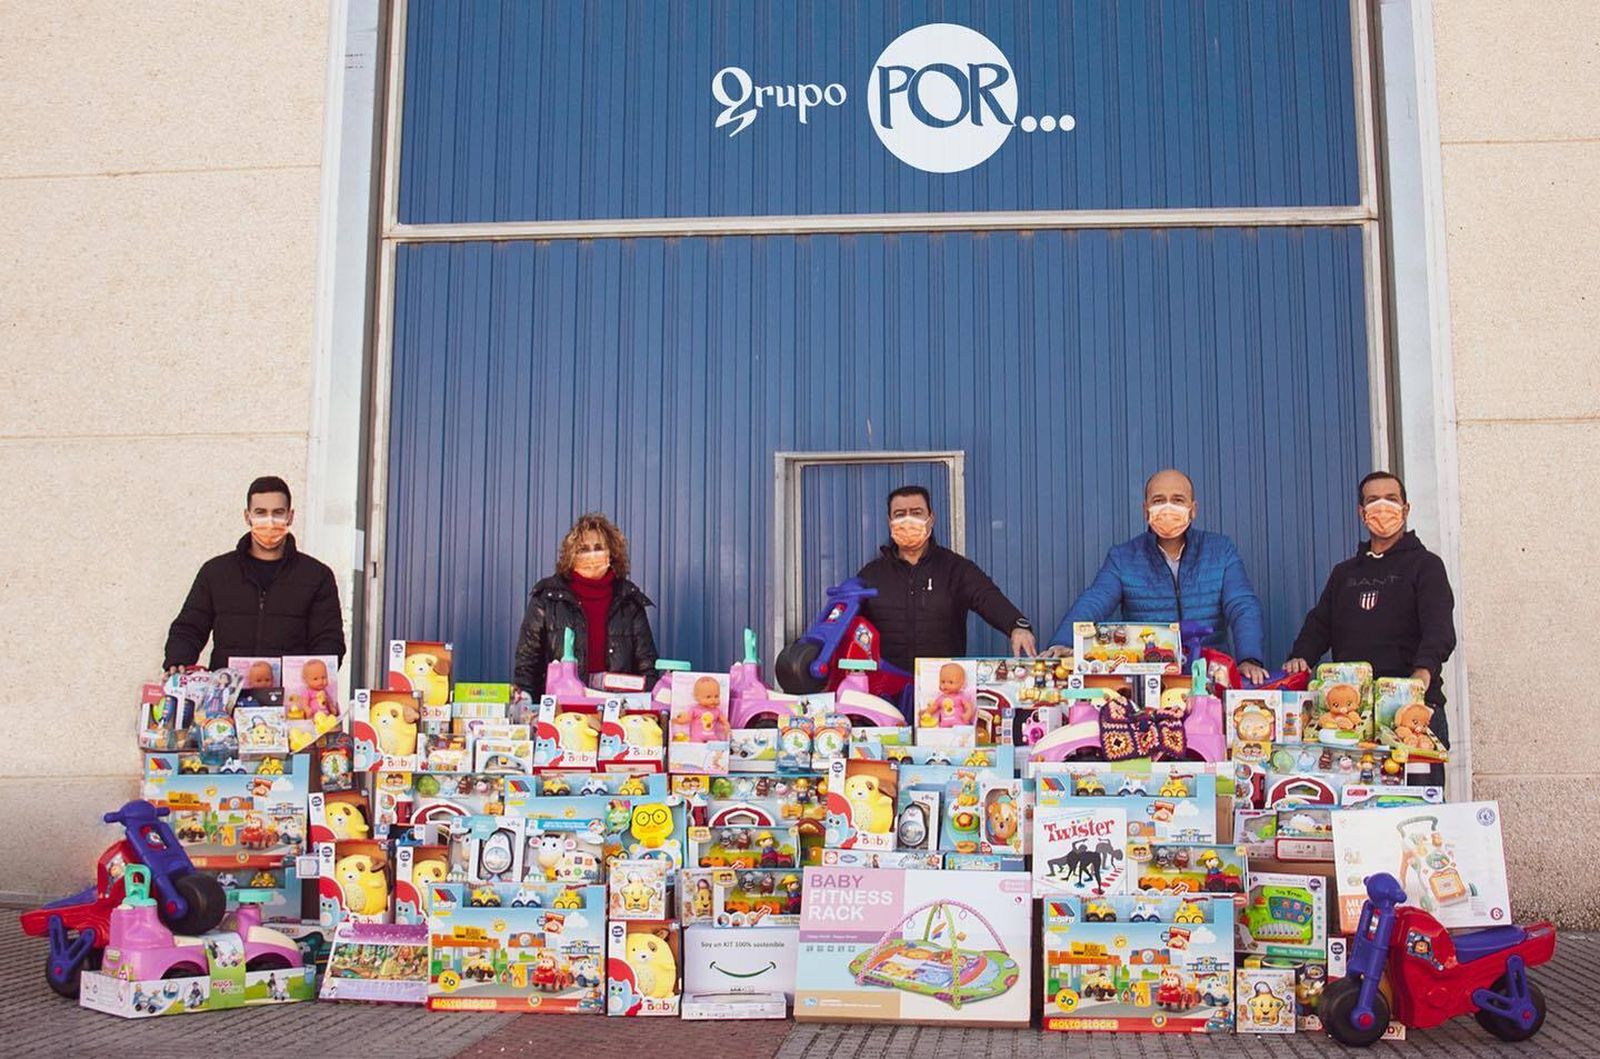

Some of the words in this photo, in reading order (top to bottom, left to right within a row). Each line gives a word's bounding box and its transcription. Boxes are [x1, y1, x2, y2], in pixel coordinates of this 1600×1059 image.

[1043, 818, 1115, 842] Twister
[810, 874, 863, 888] BABY
[808, 889, 893, 905] FITNESS
[807, 905, 864, 920] RACK
